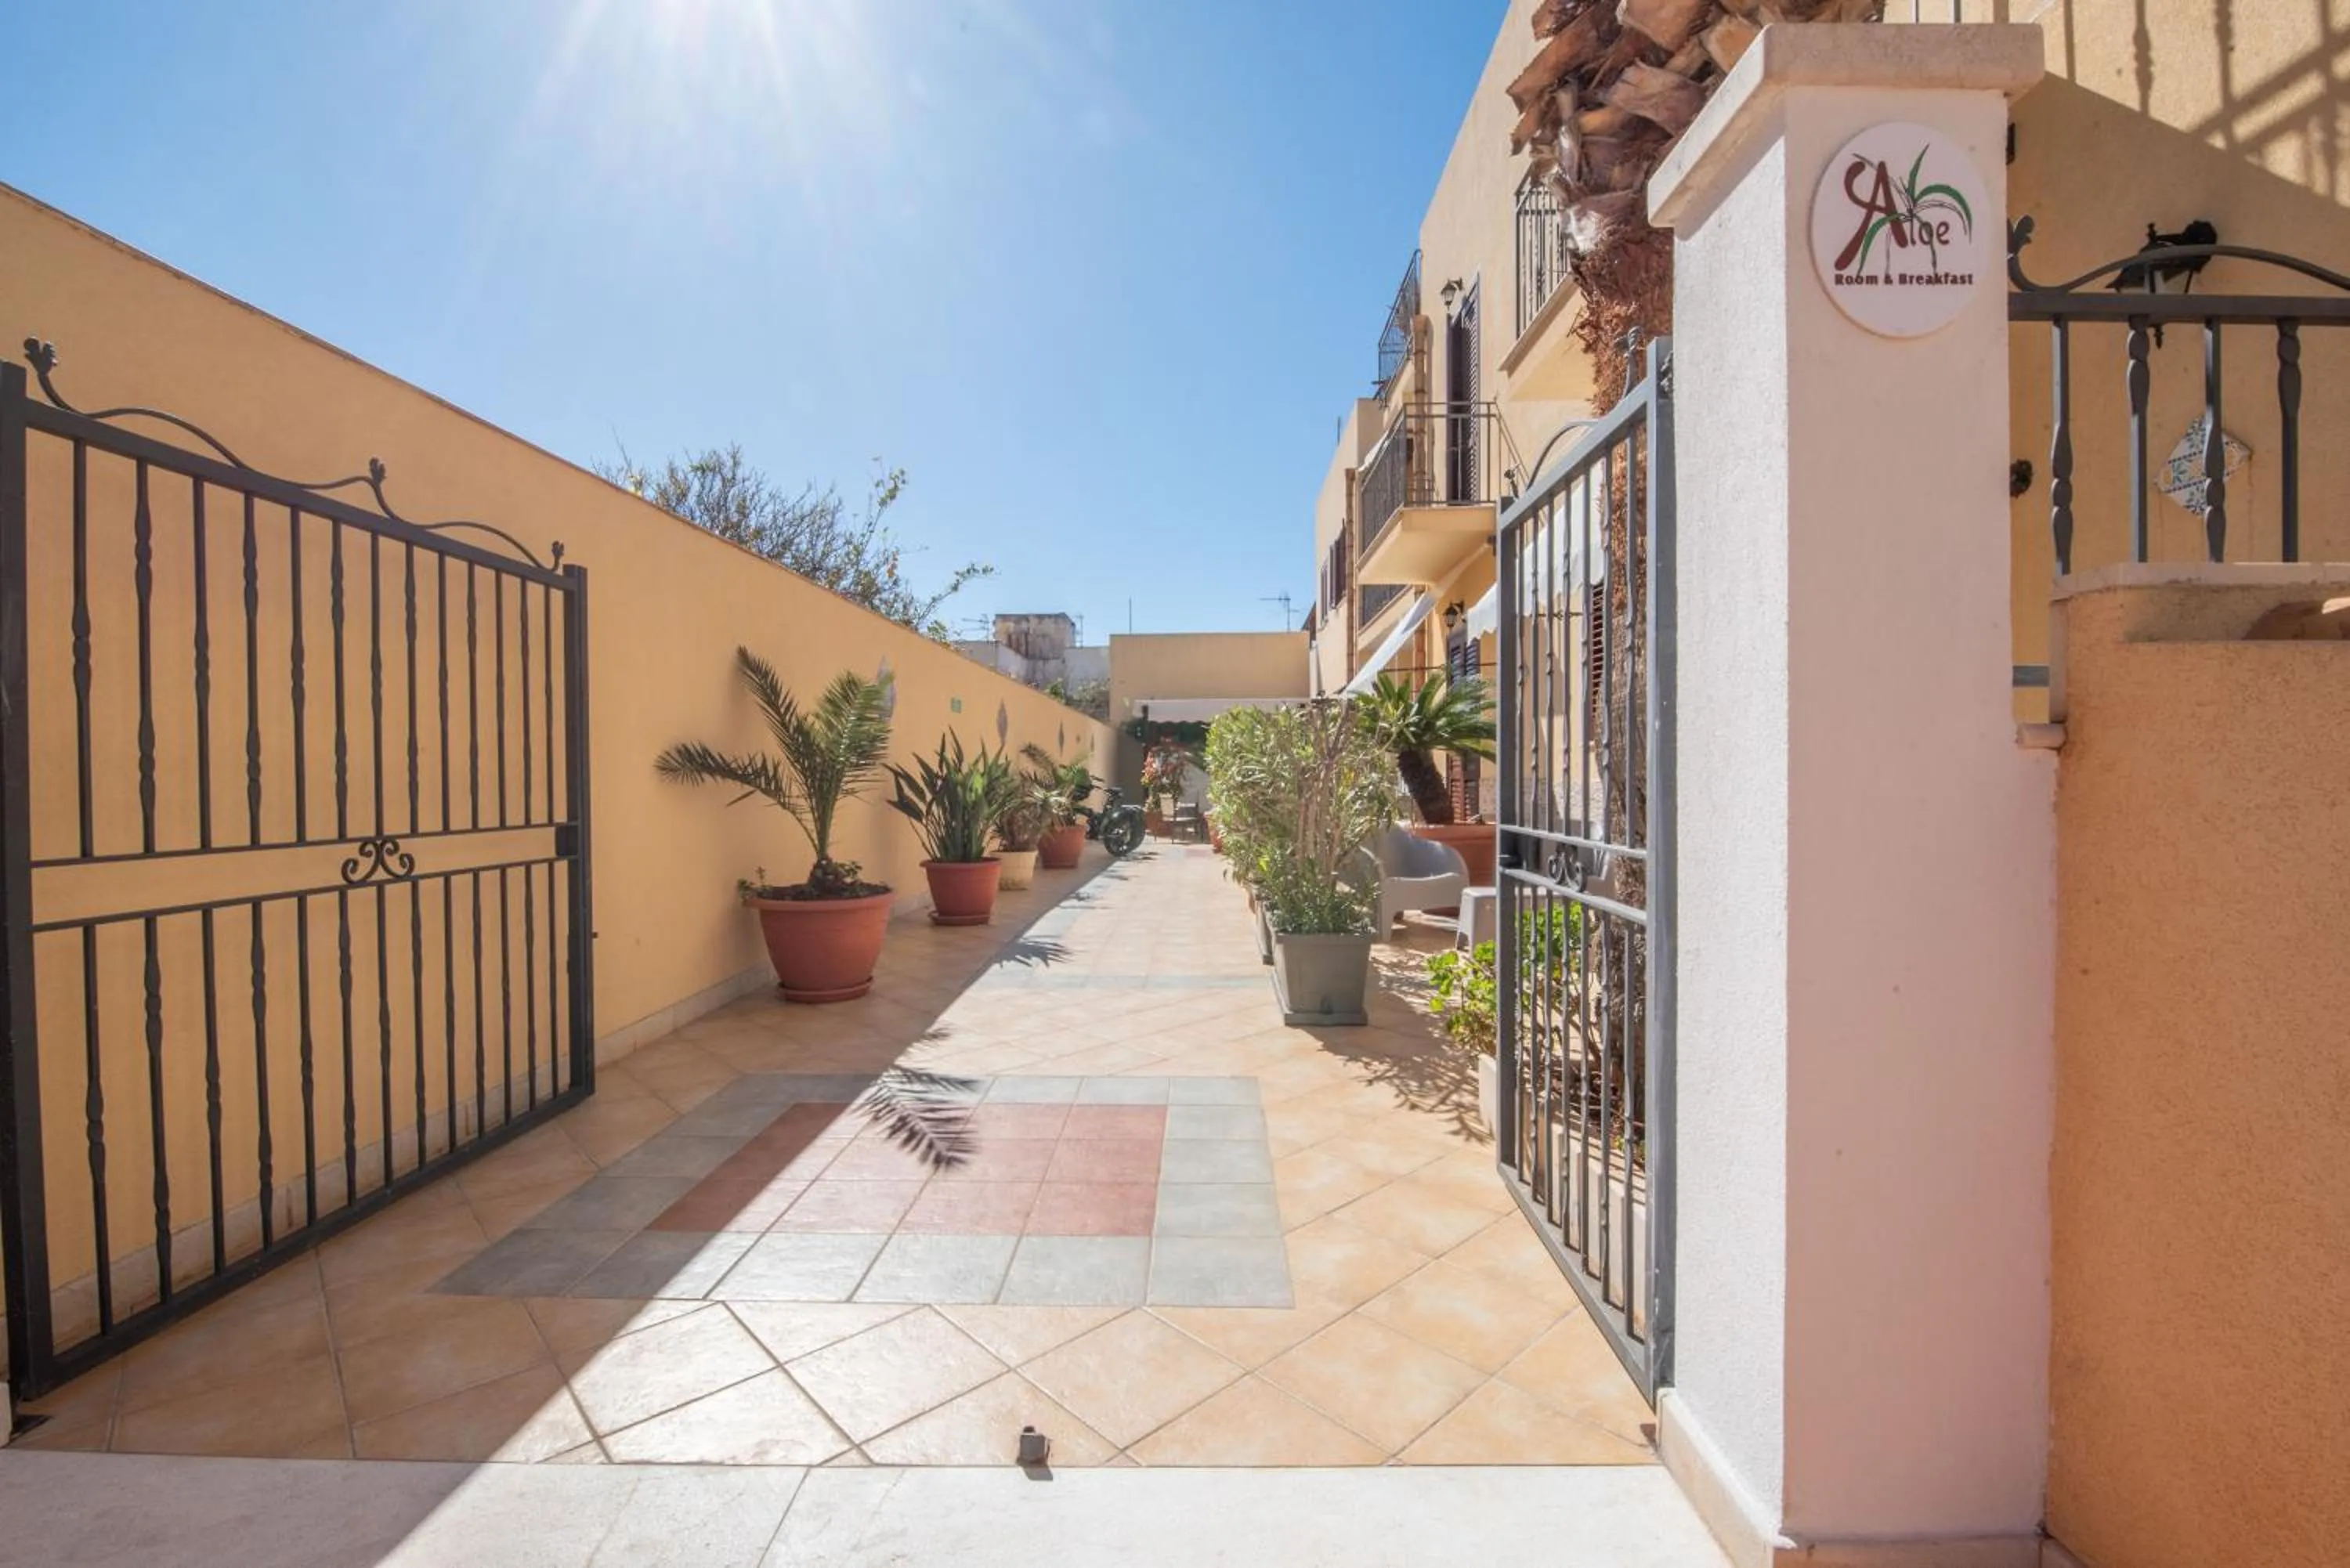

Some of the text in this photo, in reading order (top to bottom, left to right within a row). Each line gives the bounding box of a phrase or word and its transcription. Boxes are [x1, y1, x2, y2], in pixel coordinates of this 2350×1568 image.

[1834, 161, 1950, 271] Aloe
[1835, 273, 1973, 285] Room & Breakfast
